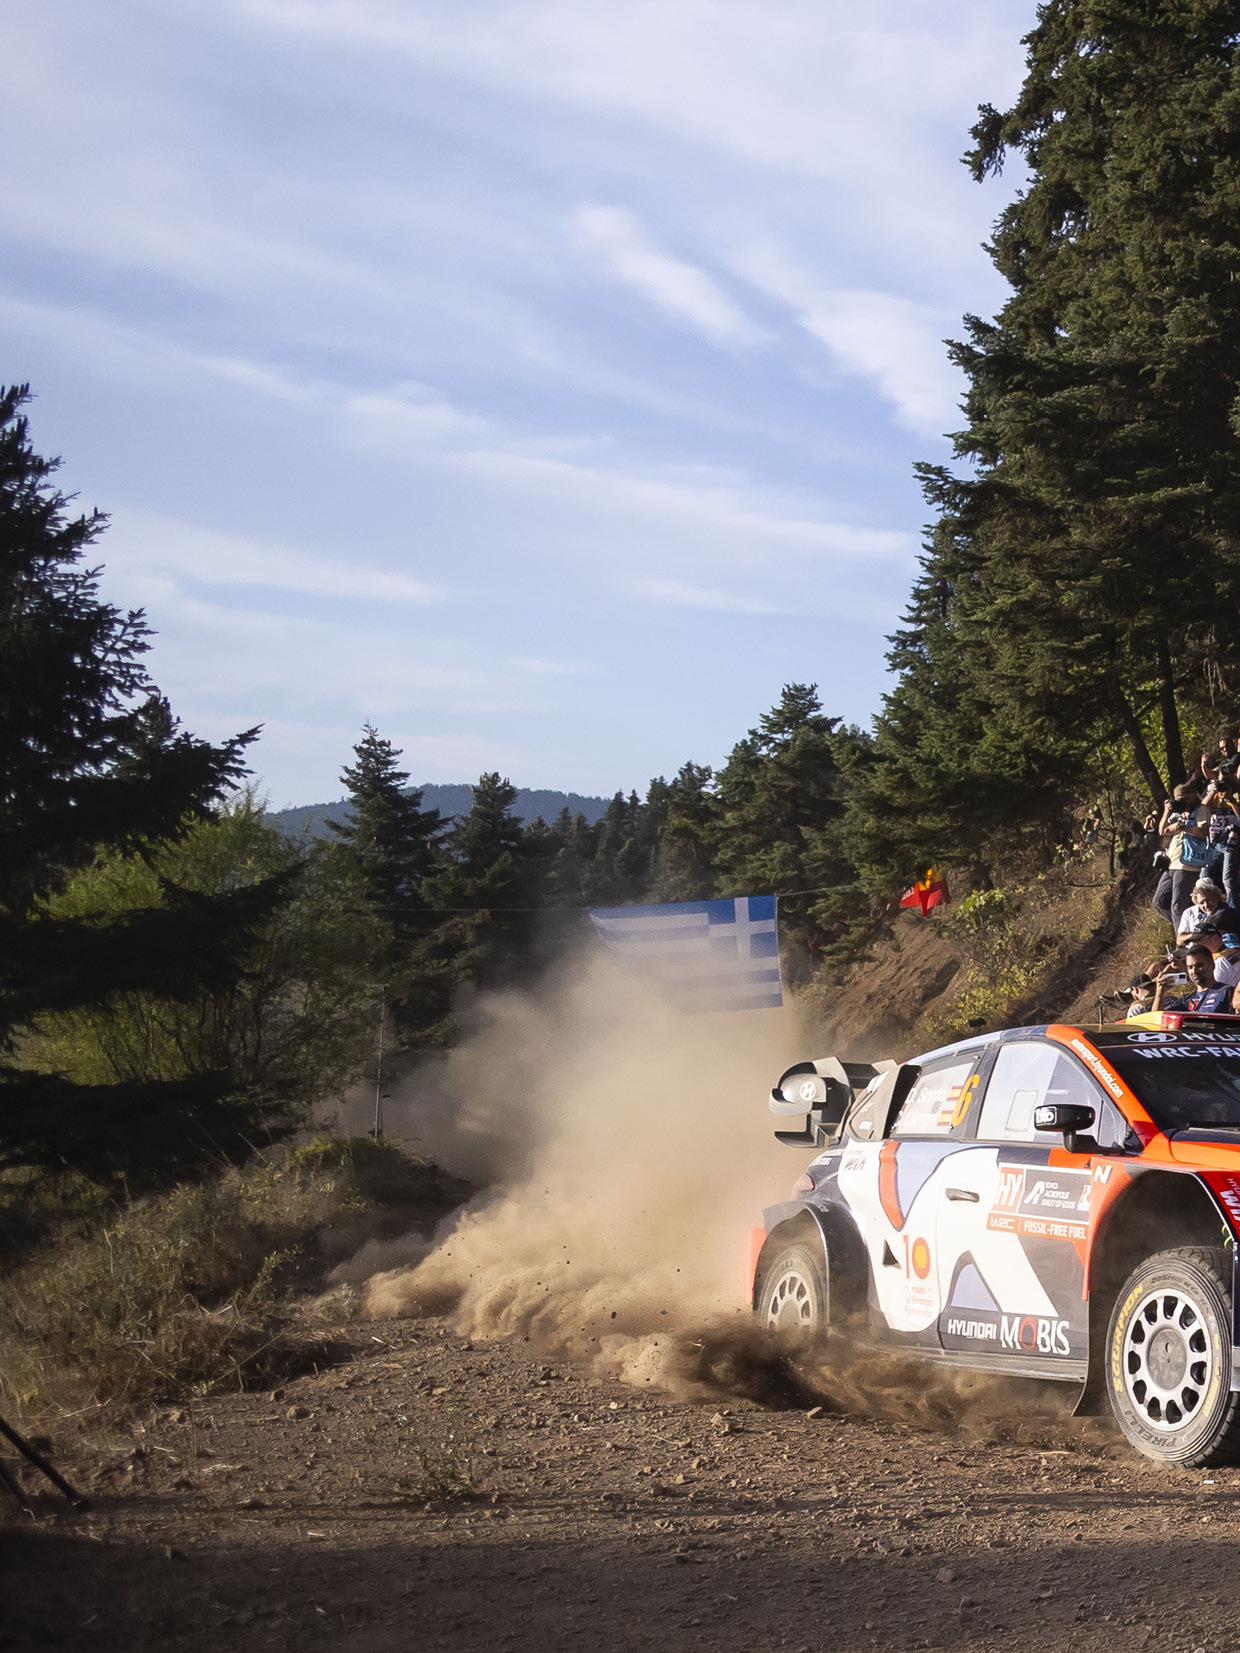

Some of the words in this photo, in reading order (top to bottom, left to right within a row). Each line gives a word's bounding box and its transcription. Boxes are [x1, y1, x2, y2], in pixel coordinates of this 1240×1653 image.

[1070, 1039, 1124, 1098] motorsport.hyundai.com
[952, 1073, 980, 1126] 6
[995, 1172, 1023, 1207] HY
[1041, 1199, 1055, 1207] RALLY
[1055, 1200, 1062, 1208] OF
[1062, 1201, 1076, 1209] GODS
[1044, 1190, 1070, 1199] ACROPOLIS
[990, 1217, 1016, 1229] WRC
[1023, 1220, 1068, 1238] FOSSIL-FREE
[1069, 1226, 1086, 1240] FUEL
[947, 1318, 997, 1340] HYUNDAI
[1000, 1315, 1071, 1355] MOBIS
[1112, 1283, 1144, 1393] SCORPION
[1124, 1409, 1177, 1449] PIRELLI
